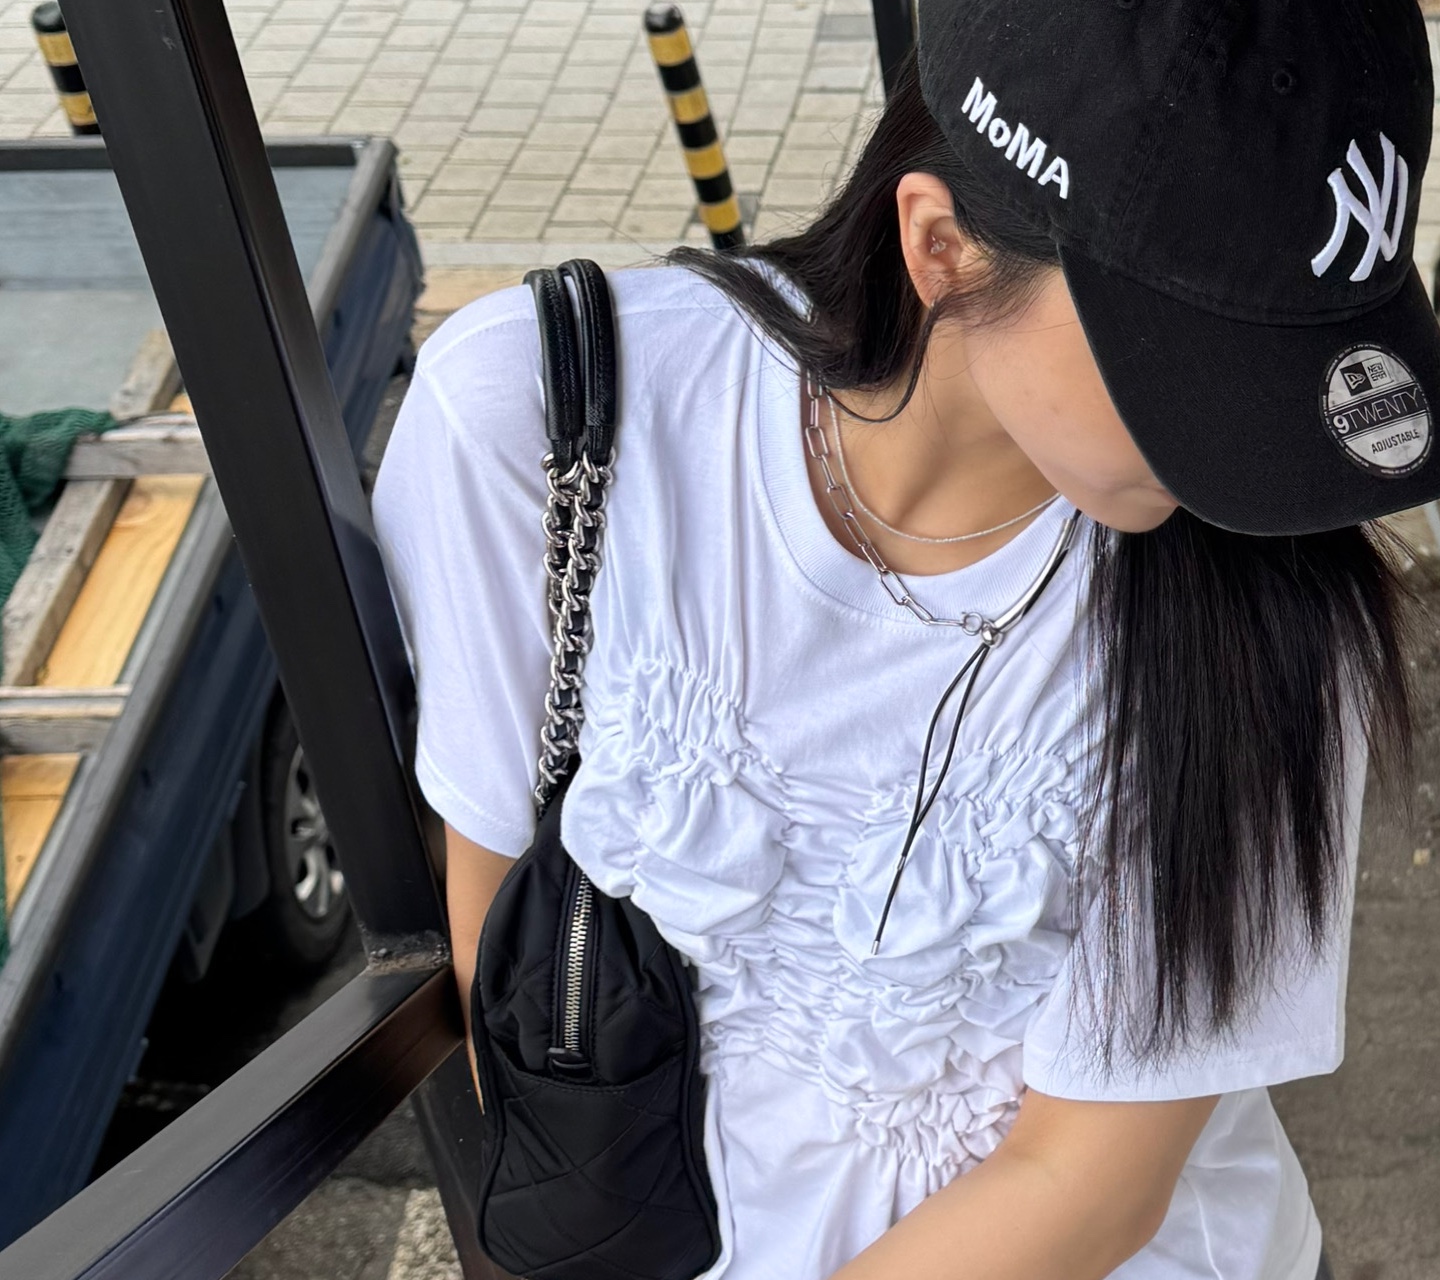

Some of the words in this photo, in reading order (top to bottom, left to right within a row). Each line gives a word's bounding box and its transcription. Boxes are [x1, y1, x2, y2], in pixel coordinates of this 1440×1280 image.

[961, 76, 1070, 199] MoMA
[1311, 131, 1409, 283] NY
[1332, 387, 1419, 435] 9TWENTY
[1371, 428, 1420, 455] ADJUSTABLE
